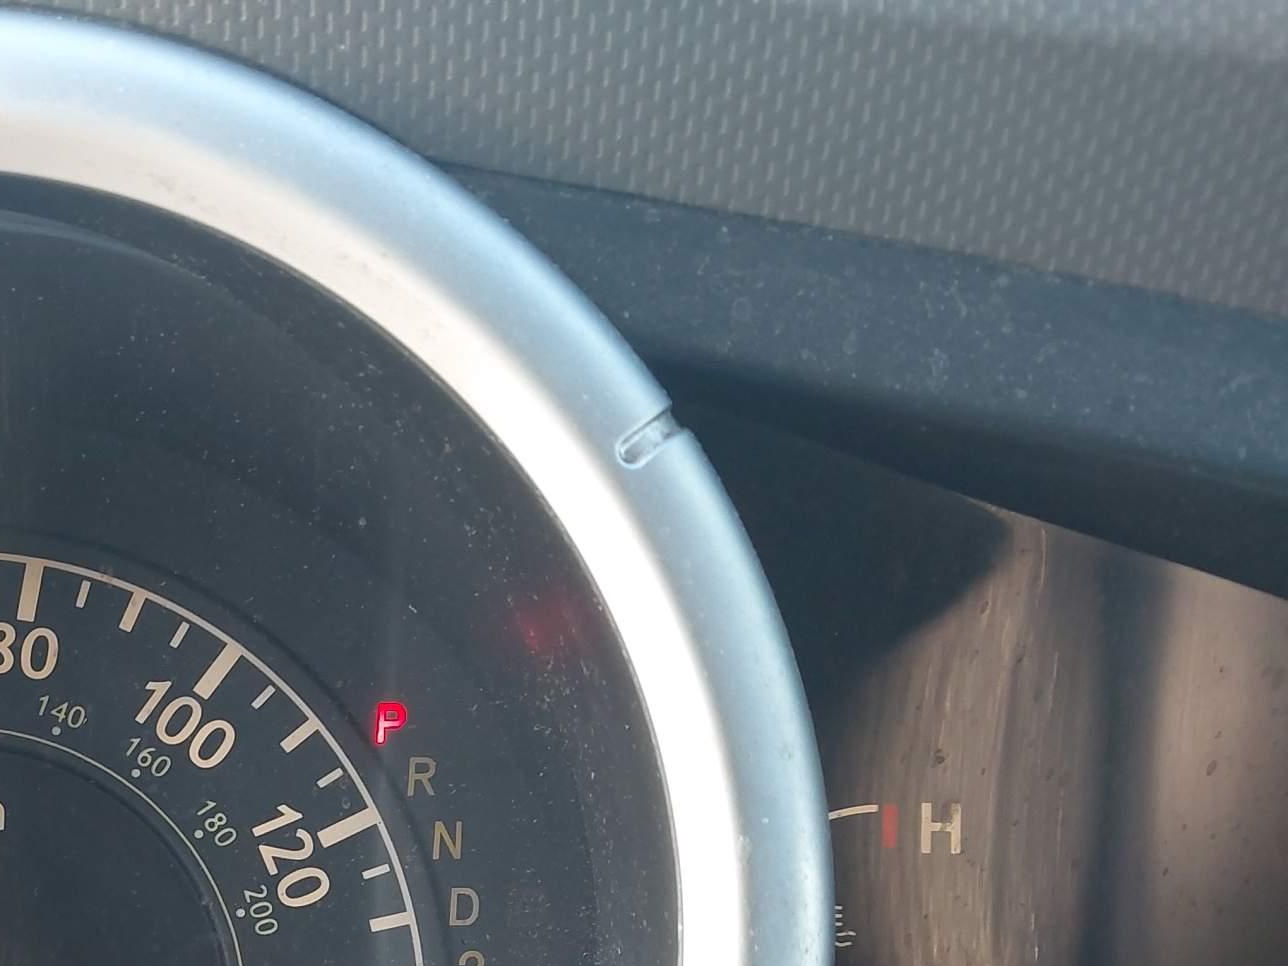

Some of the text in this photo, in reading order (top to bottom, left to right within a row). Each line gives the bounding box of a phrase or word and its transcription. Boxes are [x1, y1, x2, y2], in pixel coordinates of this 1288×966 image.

[36, 694, 86, 730] 140
[133, 679, 237, 770] 100
[374, 701, 408, 745] P
[124, 736, 172, 778] 160
[407, 757, 438, 797] R
[195, 799, 238, 848] 180
[432, 821, 463, 860] N
[920, 802, 962, 855] H
[251, 803, 331, 908] 120
[243, 884, 279, 937] 200
[449, 888, 481, 927] D
